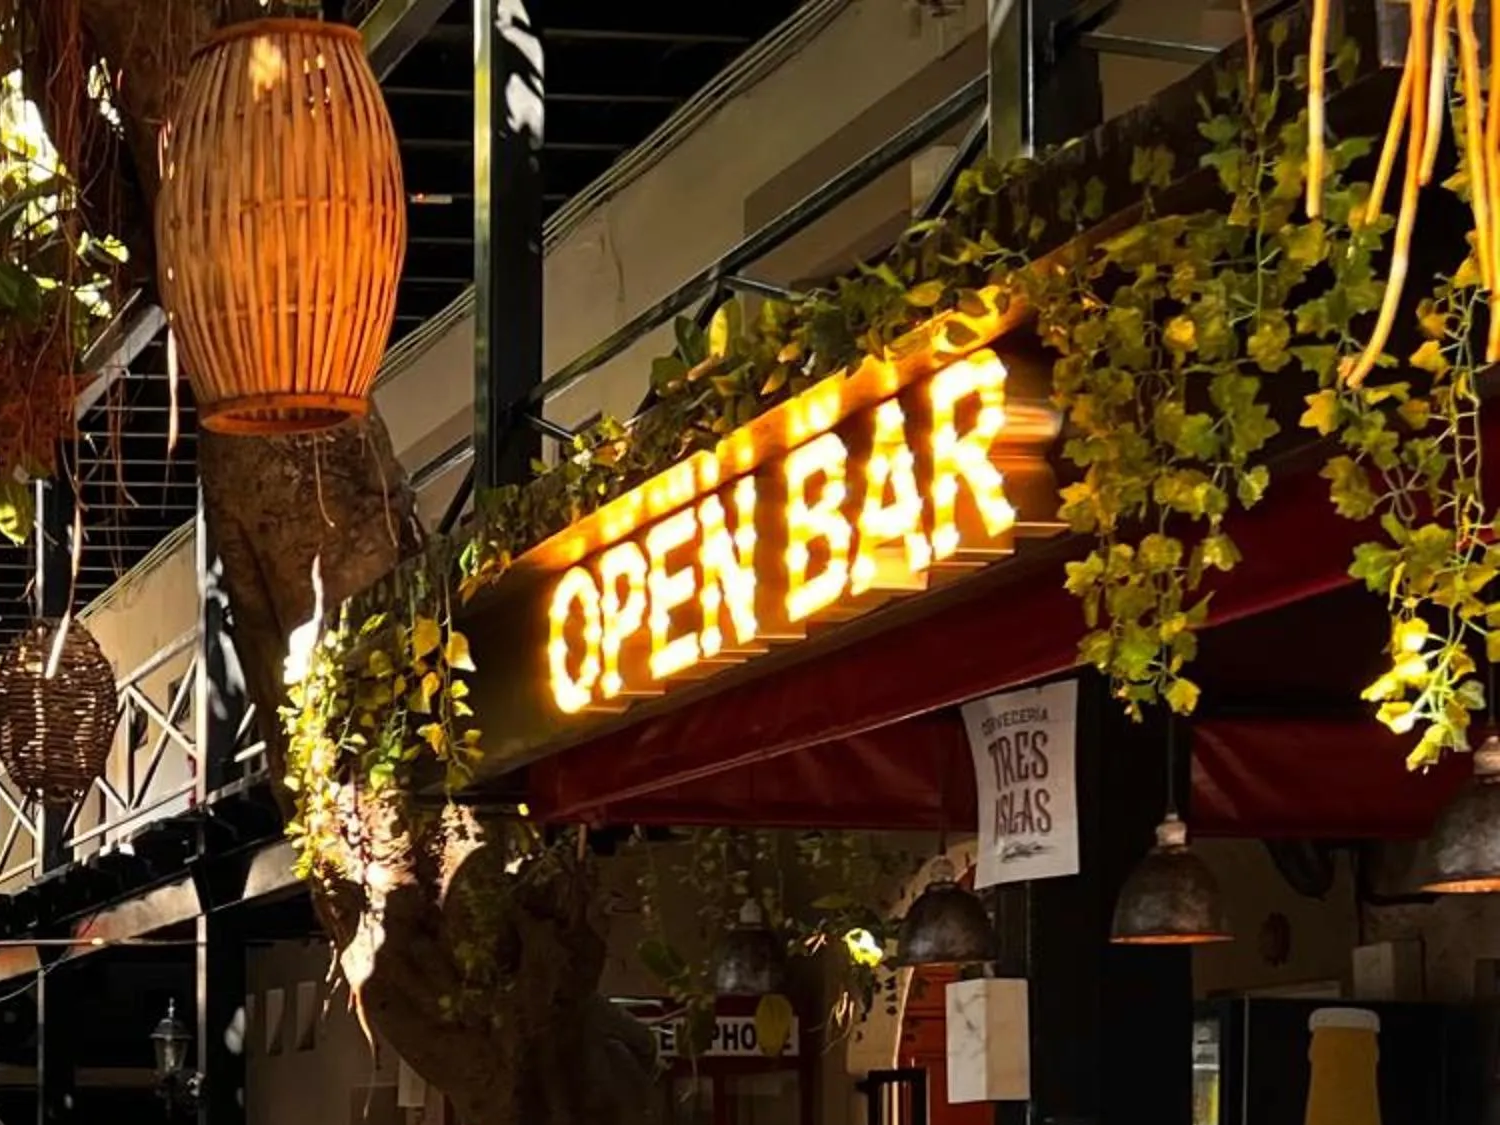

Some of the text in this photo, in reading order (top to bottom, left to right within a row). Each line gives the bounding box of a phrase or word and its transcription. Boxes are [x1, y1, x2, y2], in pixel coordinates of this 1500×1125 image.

[548, 348, 1016, 714] OPEN BAR
[987, 731, 1049, 791] TRES
[995, 788, 1052, 846] ISLAS
